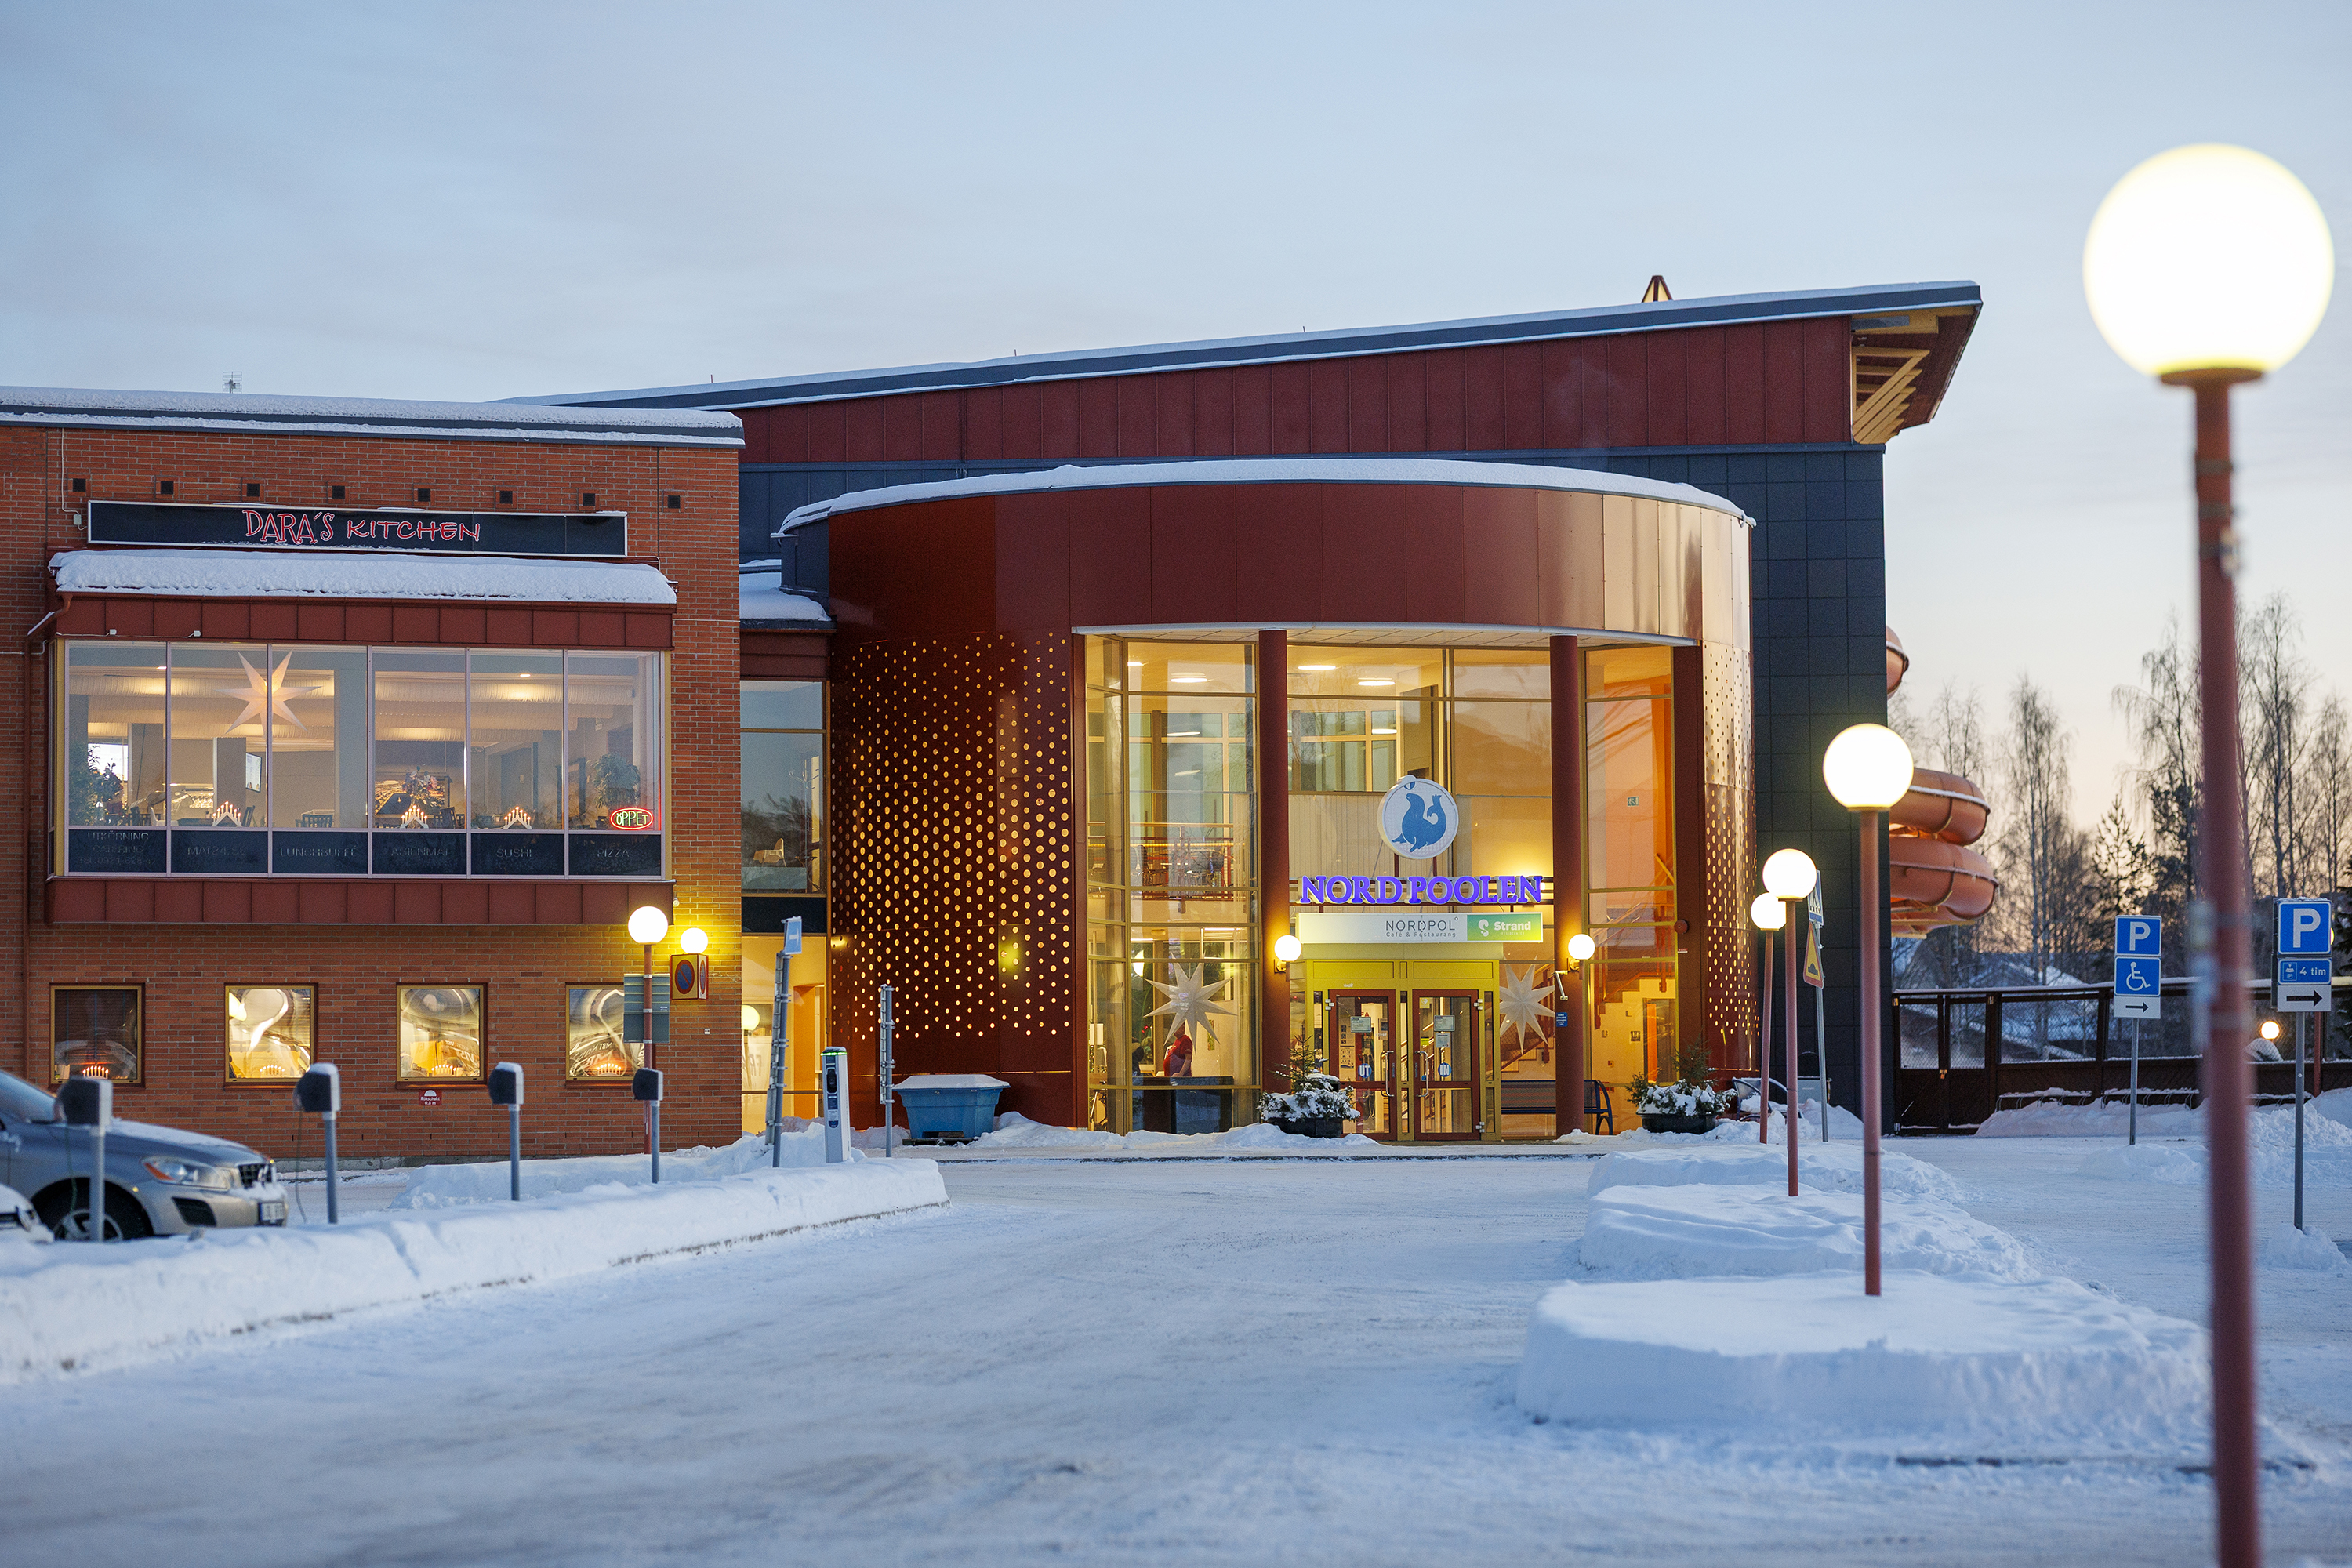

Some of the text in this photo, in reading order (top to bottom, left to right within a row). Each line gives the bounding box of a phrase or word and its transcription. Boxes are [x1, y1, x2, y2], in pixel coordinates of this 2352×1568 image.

[346, 518, 481, 543] KITCHEN
[87, 829, 149, 840] UTKÖRNING
[495, 848, 532, 858] SUSHI
[597, 848, 630, 858] PIZZA
[1494, 921, 1531, 931] Strand
[2293, 908, 2321, 948] P
[2129, 921, 2151, 951] P
[2299, 967, 2326, 976] 4 tim
[1359, 1065, 1370, 1076] UT
[1439, 1064, 1450, 1076] IN
